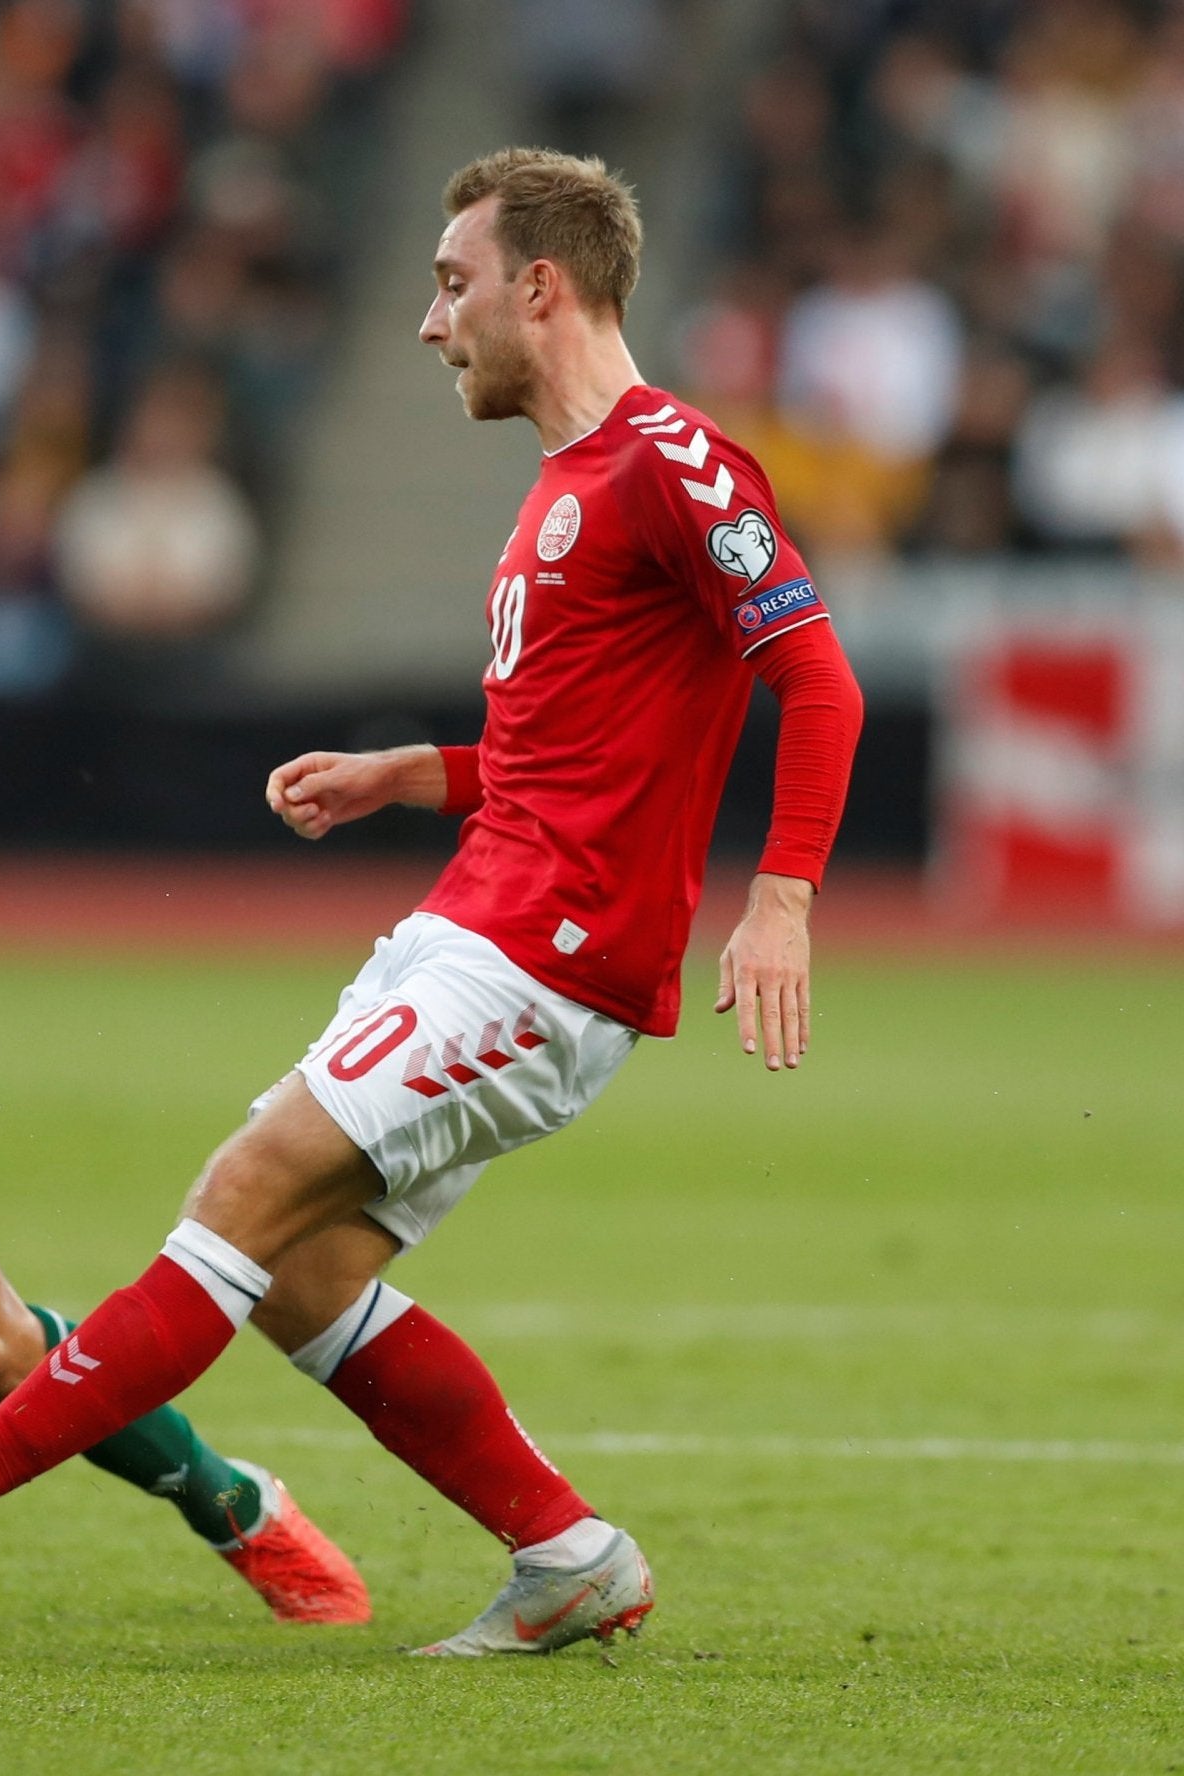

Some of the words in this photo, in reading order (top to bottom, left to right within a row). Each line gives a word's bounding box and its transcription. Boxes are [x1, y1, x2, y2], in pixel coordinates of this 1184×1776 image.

[486, 574, 525, 680] 10
[760, 584, 814, 615] RESPECT
[309, 998, 417, 1081] 0
